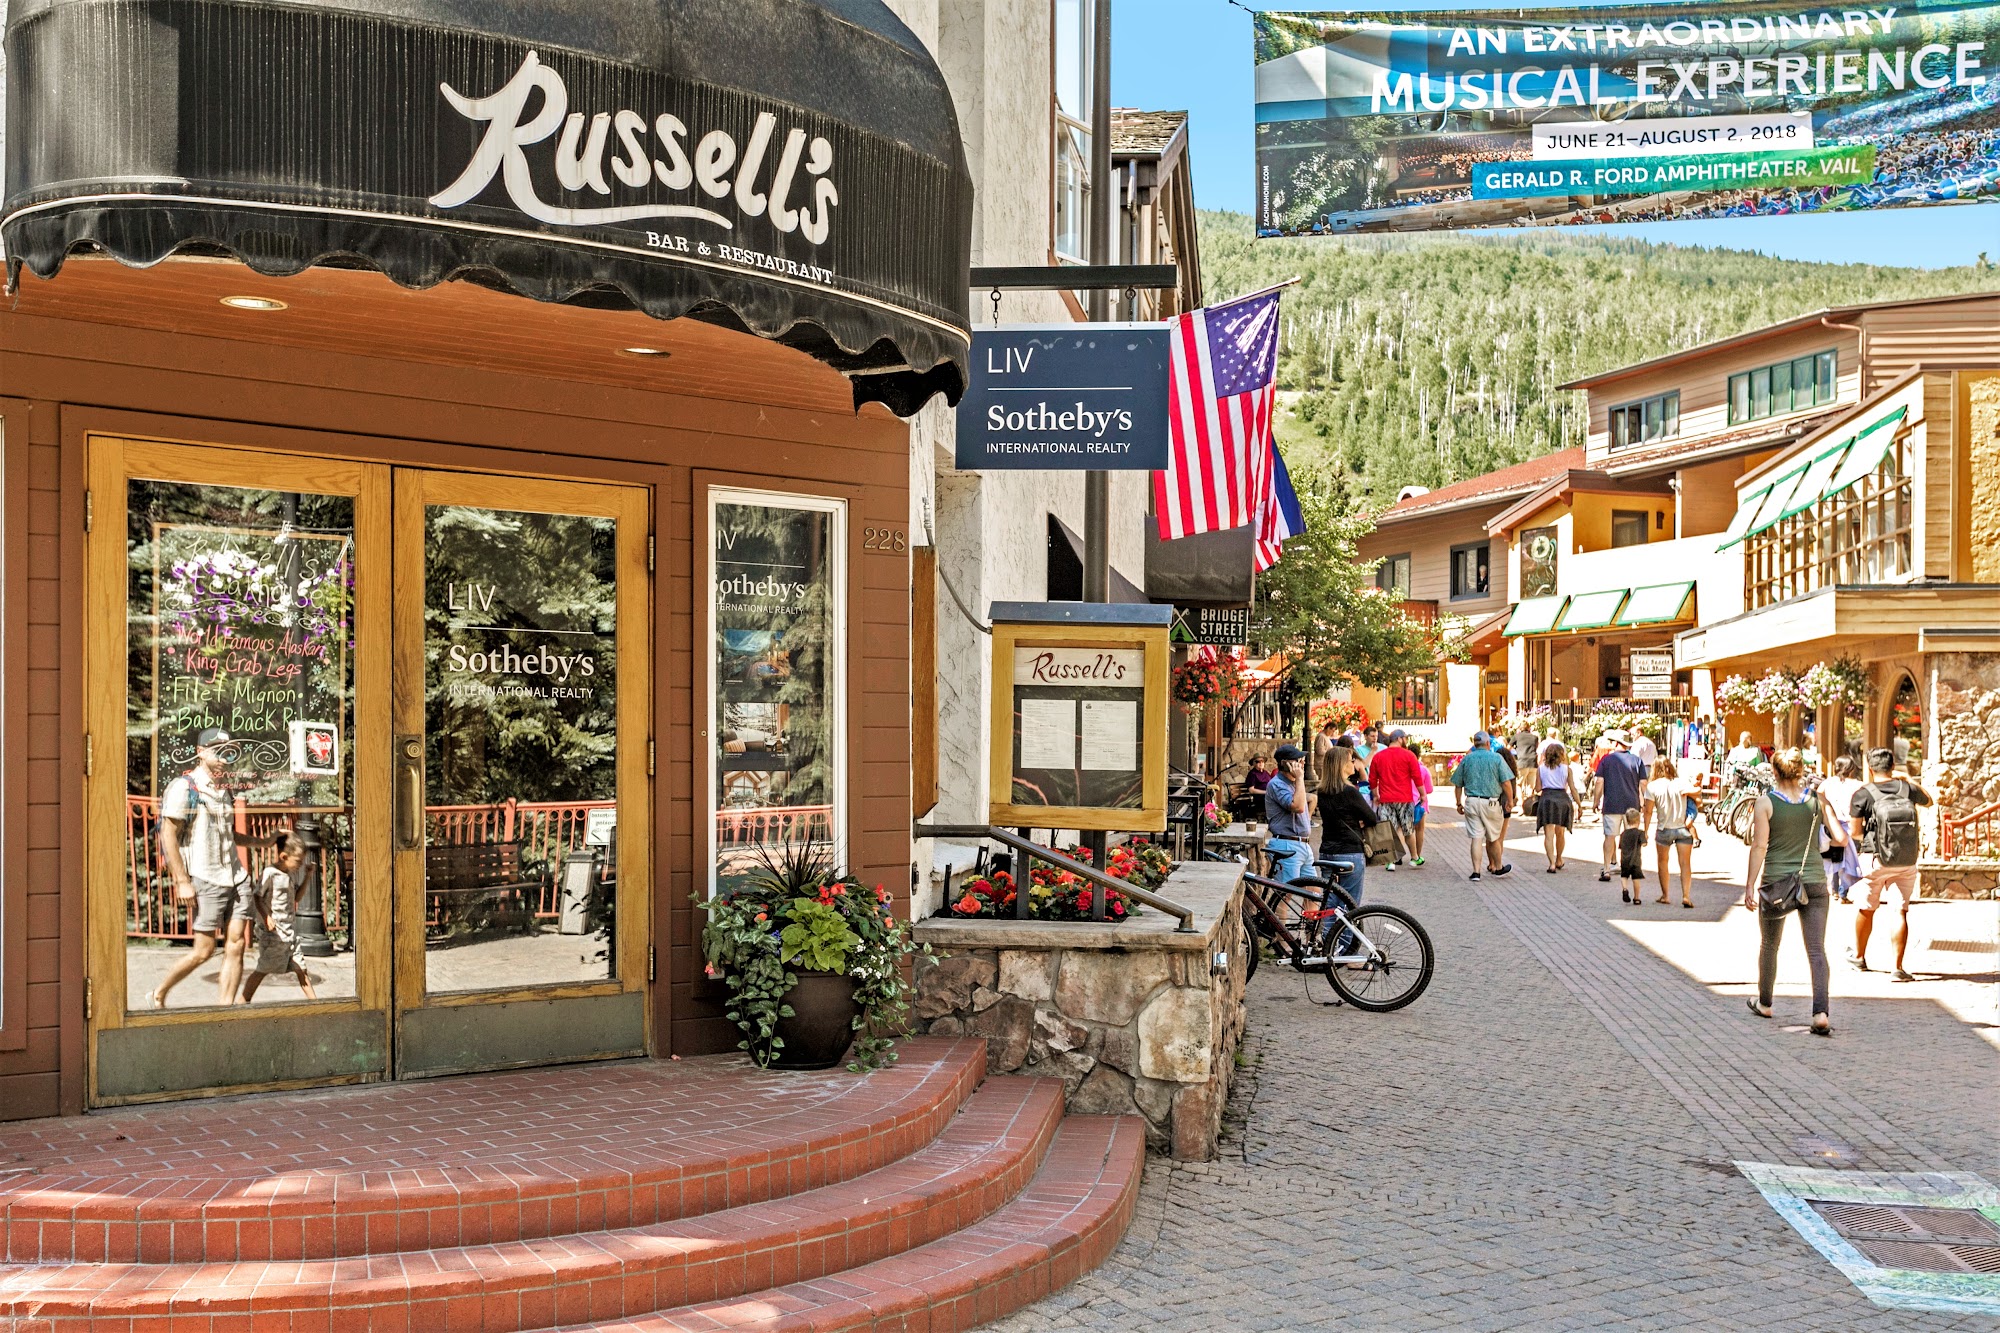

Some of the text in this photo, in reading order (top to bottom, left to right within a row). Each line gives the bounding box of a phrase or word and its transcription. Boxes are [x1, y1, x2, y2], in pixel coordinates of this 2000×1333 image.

[1447, 8, 1897, 57] AN EXTRAORDINARY
[1371, 42, 1986, 113] MUSICAL EXPERIENCE
[428, 49, 838, 245] Russell's
[1548, 133, 1598, 149] JUNE
[1727, 127, 1743, 142] 2,
[1751, 124, 1796, 140] 2018
[1486, 157, 1861, 189] GERALD R. FORD AMPHITHEATER, VAIL
[646, 231, 833, 285] BAR & RESTAURANT
[987, 347, 1033, 373] LIV
[987, 402, 1133, 437] Sotheby's
[986, 442, 1131, 453] INTERNATIONAL REALTY
[716, 530, 737, 551] IV
[863, 527, 905, 552] 228
[448, 582, 496, 612] LIV
[716, 602, 804, 615] TERNATIONAL REALTY
[1200, 608, 1244, 622] BRIDGE
[1200, 622, 1244, 636] STREET
[176, 622, 220, 648] World
[223, 626, 275, 652] Famous
[1200, 636, 1243, 644] LOCKERS
[186, 648, 303, 686] King Crab Legs
[449, 643, 595, 682] Sotheby's
[1024, 650, 1127, 683] Russell's
[173, 676, 296, 714] Filet Mignon
[449, 684, 594, 699] INTERNATIONAL REALTY
[177, 706, 224, 740] Baby
